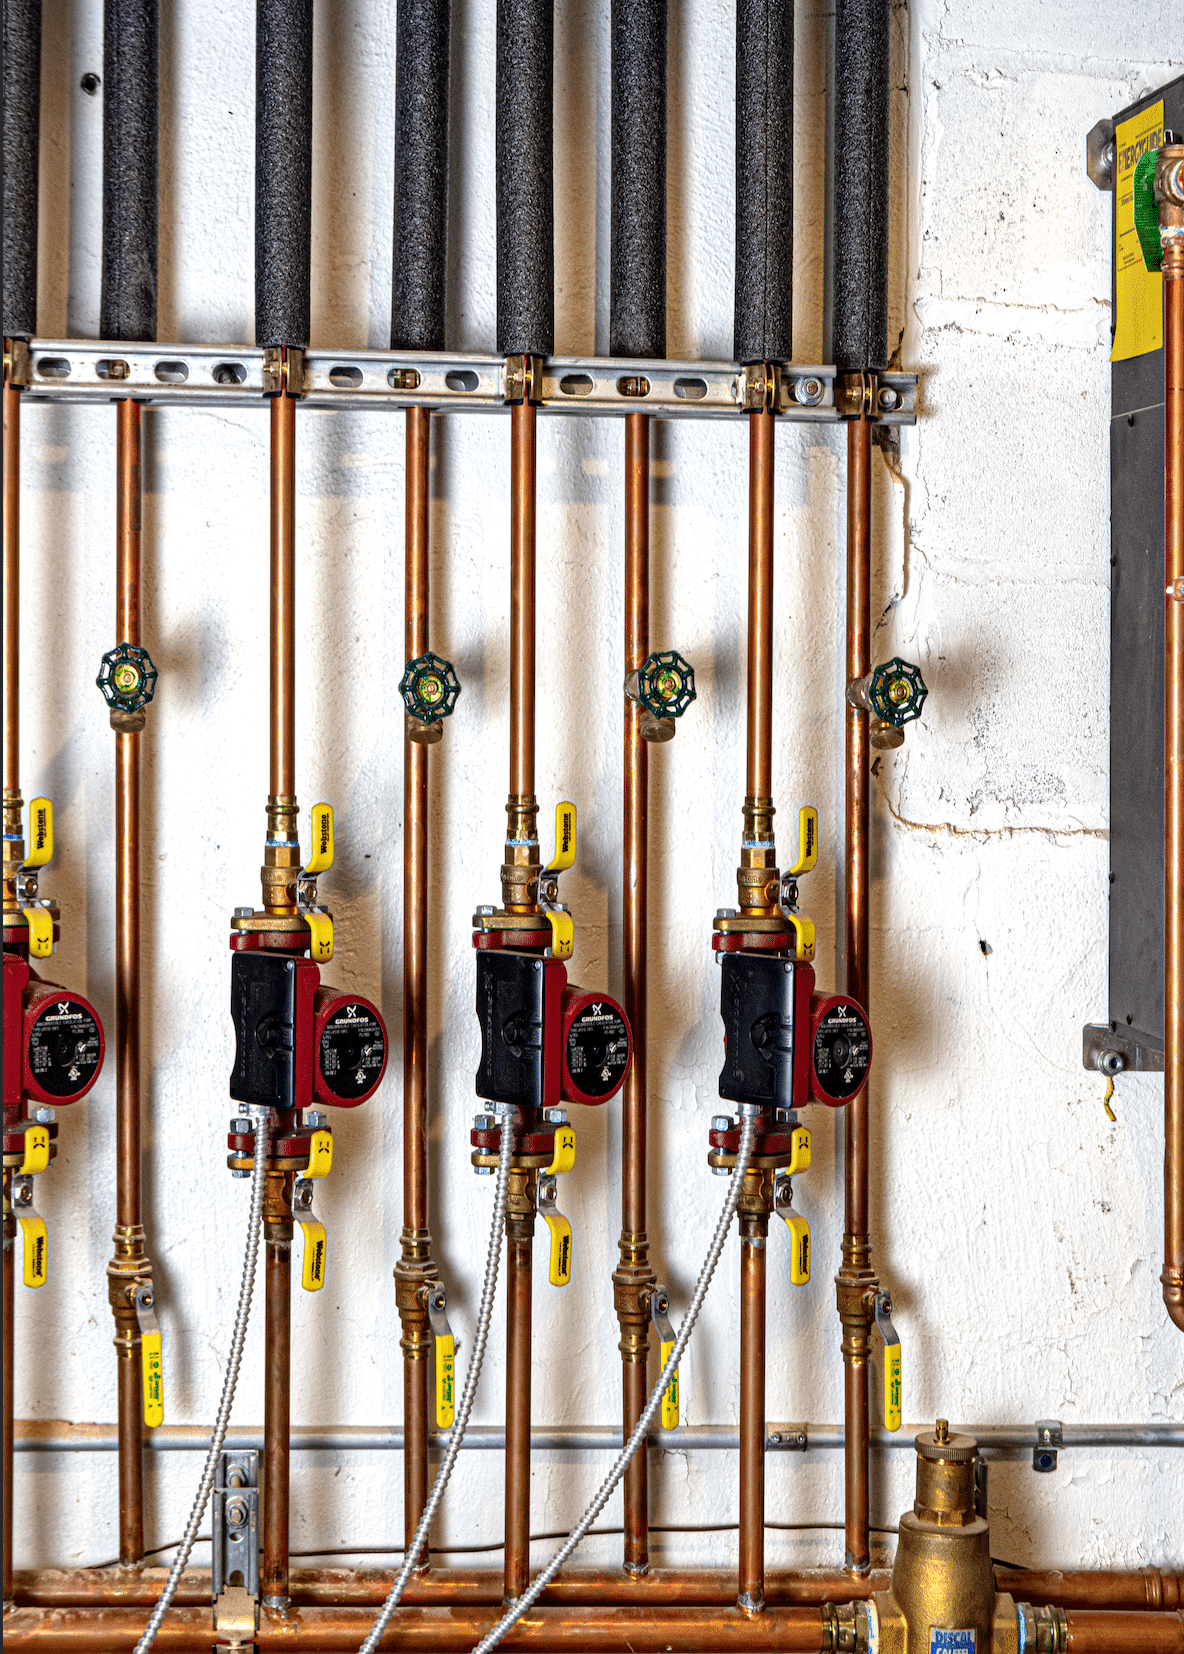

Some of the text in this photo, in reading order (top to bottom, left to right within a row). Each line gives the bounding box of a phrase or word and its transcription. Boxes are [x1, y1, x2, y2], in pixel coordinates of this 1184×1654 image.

[36, 809, 44, 850] Webstone
[45, 1013, 83, 1022] GRUNDFOS
[335, 1016, 369, 1025] GRUNDFOS
[581, 1014, 614, 1022] GRUNDFOS
[935, 1631, 971, 1643] DISCAL
